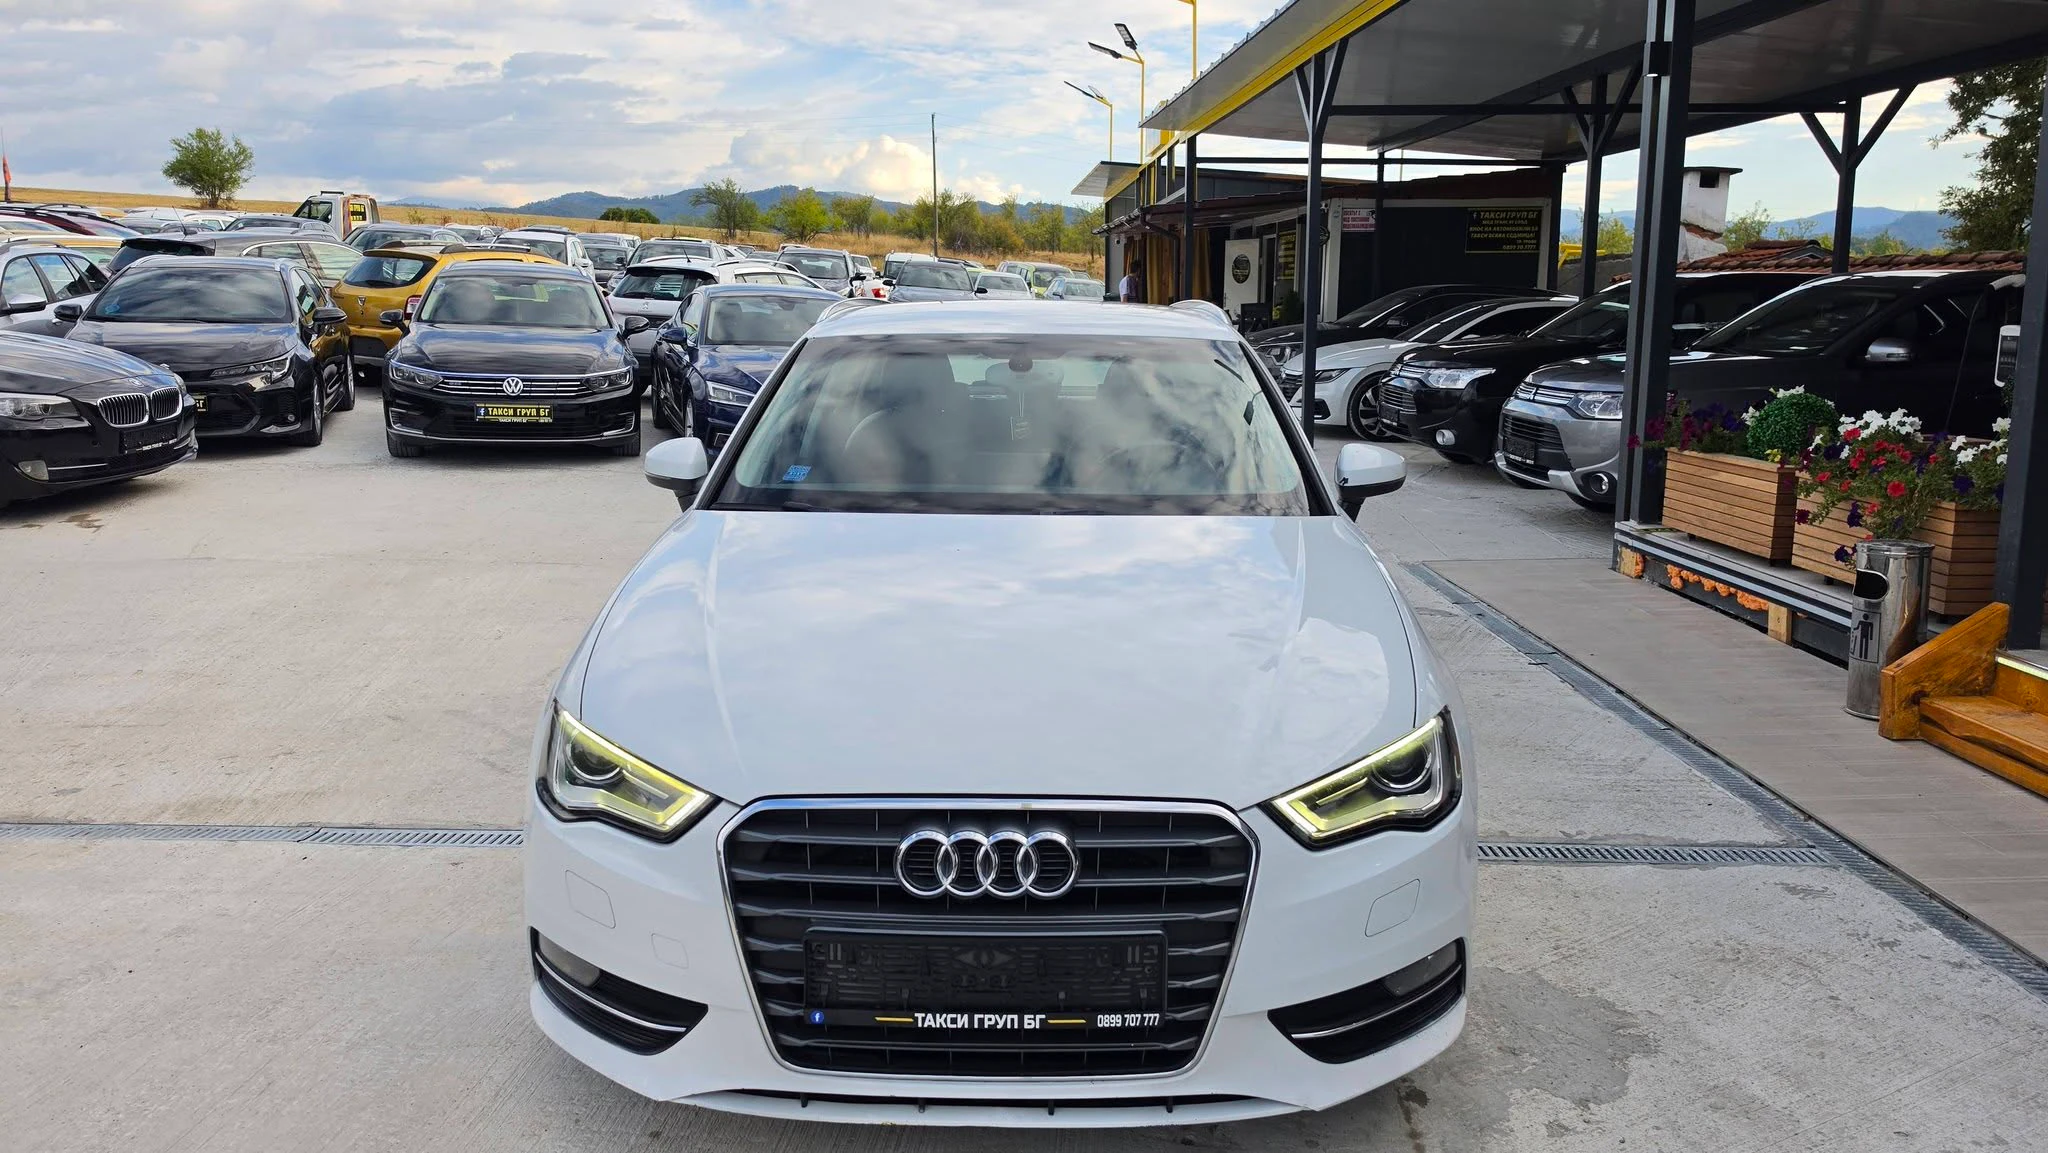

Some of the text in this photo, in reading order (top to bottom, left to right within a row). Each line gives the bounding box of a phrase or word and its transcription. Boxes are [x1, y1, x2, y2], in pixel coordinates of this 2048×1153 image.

[488, 407, 514, 416] ТАКСИ
[517, 408, 537, 416] ГРУП
[539, 408, 550, 416] БГ
[914, 1012, 969, 1029] ТАКСИ
[973, 1013, 1019, 1029] ГРУП
[1023, 1013, 1046, 1029] БГ
[1097, 1014, 1122, 1028] 0899
[1124, 1013, 1141, 1027] 707
[1143, 1013, 1160, 1027] 777
